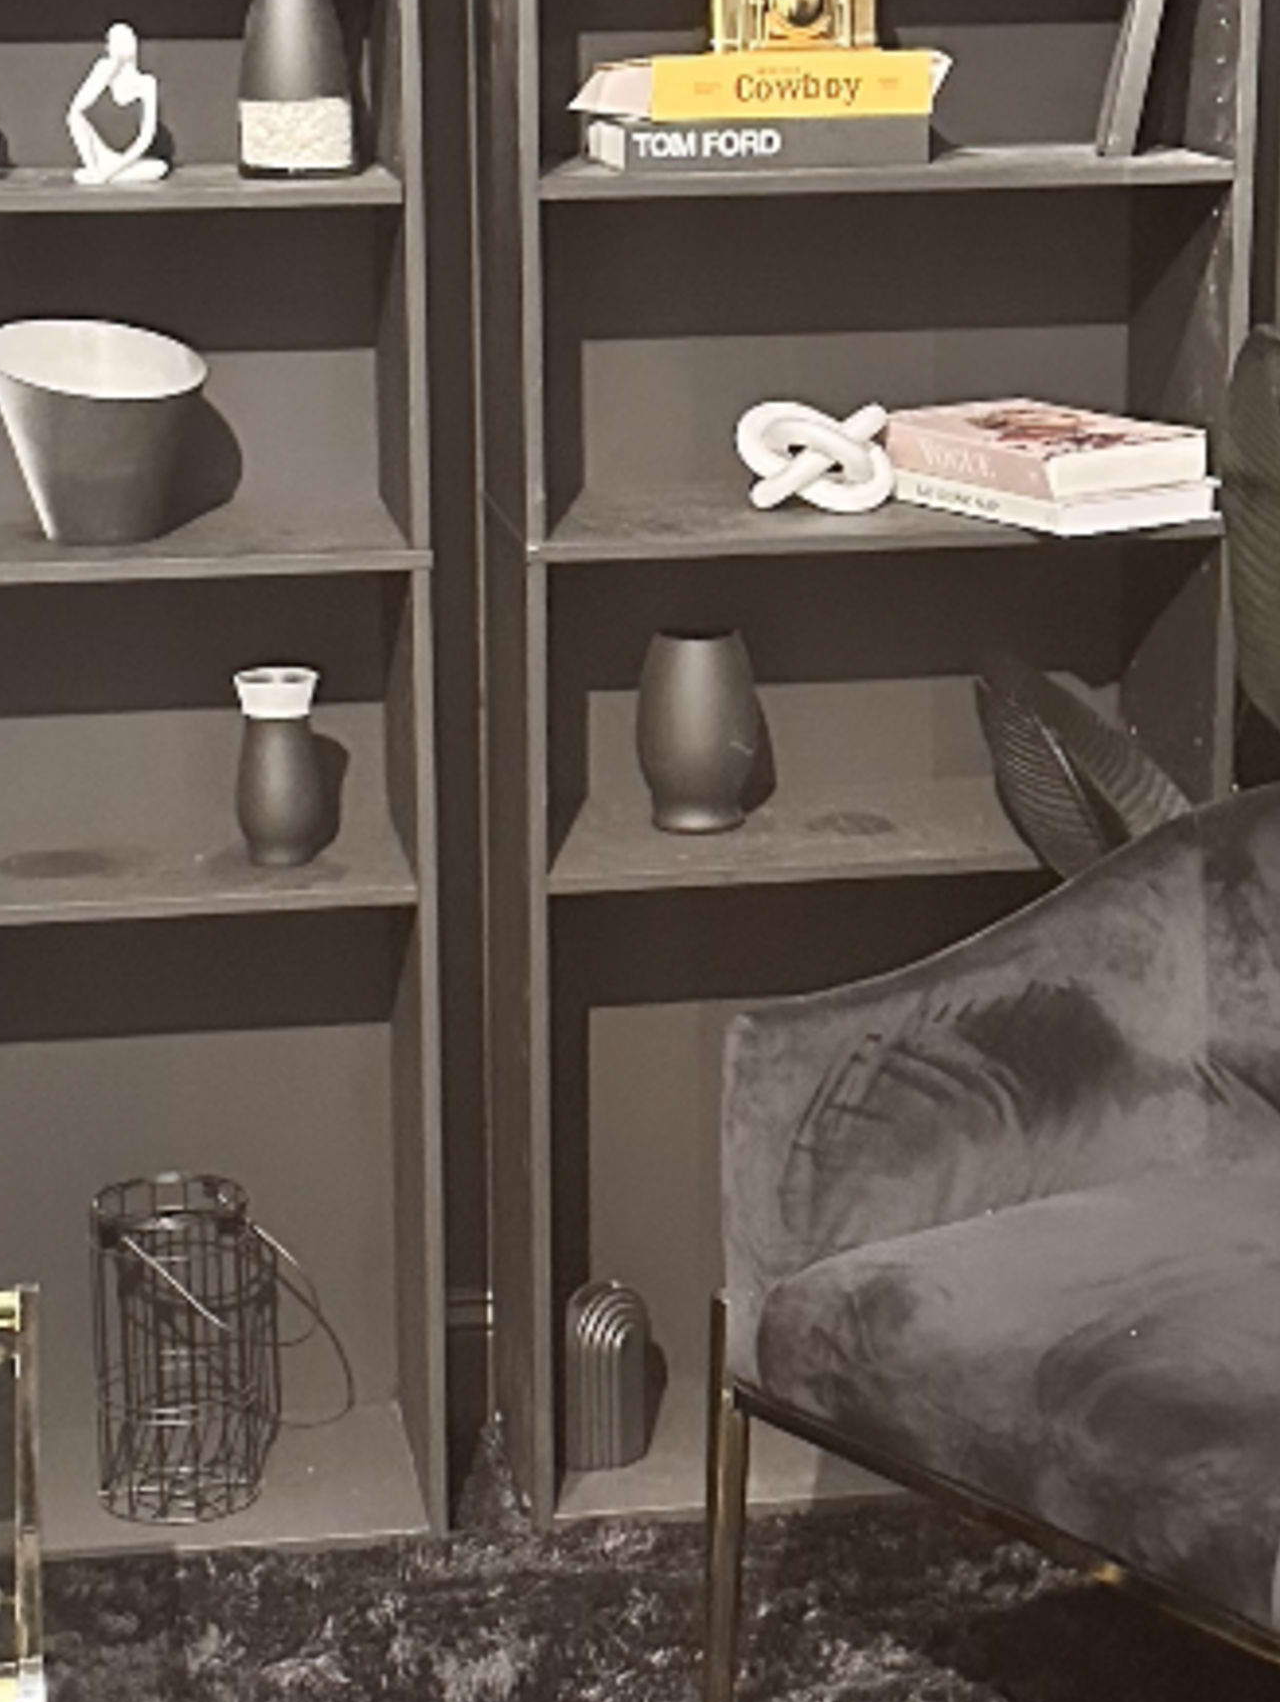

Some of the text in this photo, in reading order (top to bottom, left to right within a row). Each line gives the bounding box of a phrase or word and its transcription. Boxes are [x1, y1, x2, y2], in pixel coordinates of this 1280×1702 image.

[734, 73, 863, 106] Cowboy
[633, 128, 782, 158] TOM FORD
